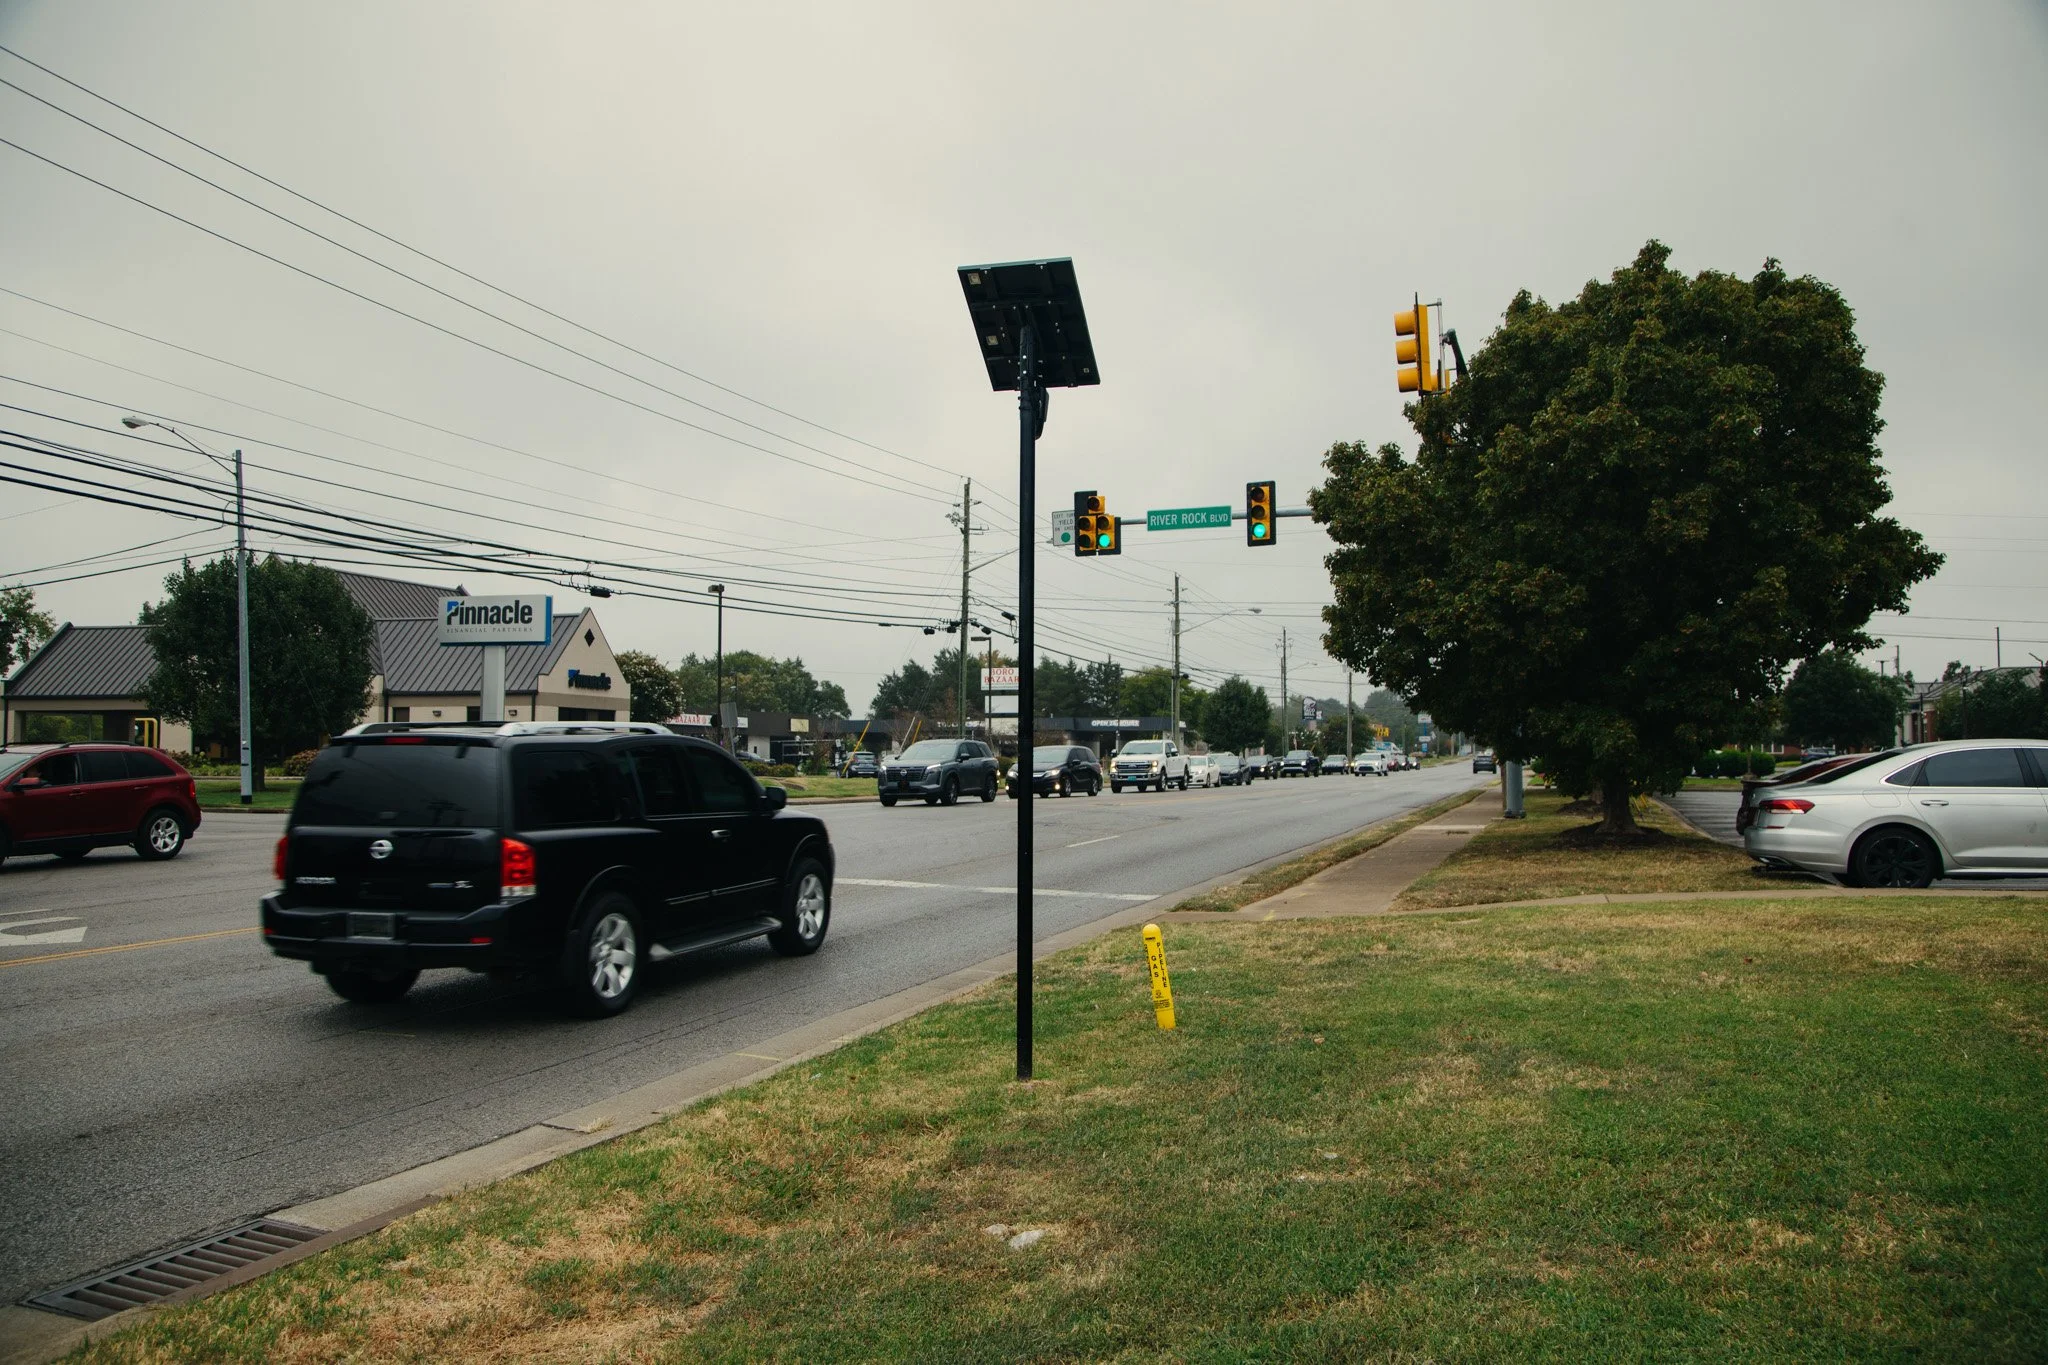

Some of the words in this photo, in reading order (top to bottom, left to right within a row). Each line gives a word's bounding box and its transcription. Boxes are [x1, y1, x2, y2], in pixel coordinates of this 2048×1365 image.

[1150, 514, 1177, 526] RIVER
[1181, 512, 1207, 525] ROCK
[1210, 513, 1228, 523] BLVD
[446, 600, 533, 625] Pinnacle
[1091, 719, 1108, 727] OPEN
[1151, 955, 1159, 978] GAS
[1156, 942, 1168, 988] PIPELINE
